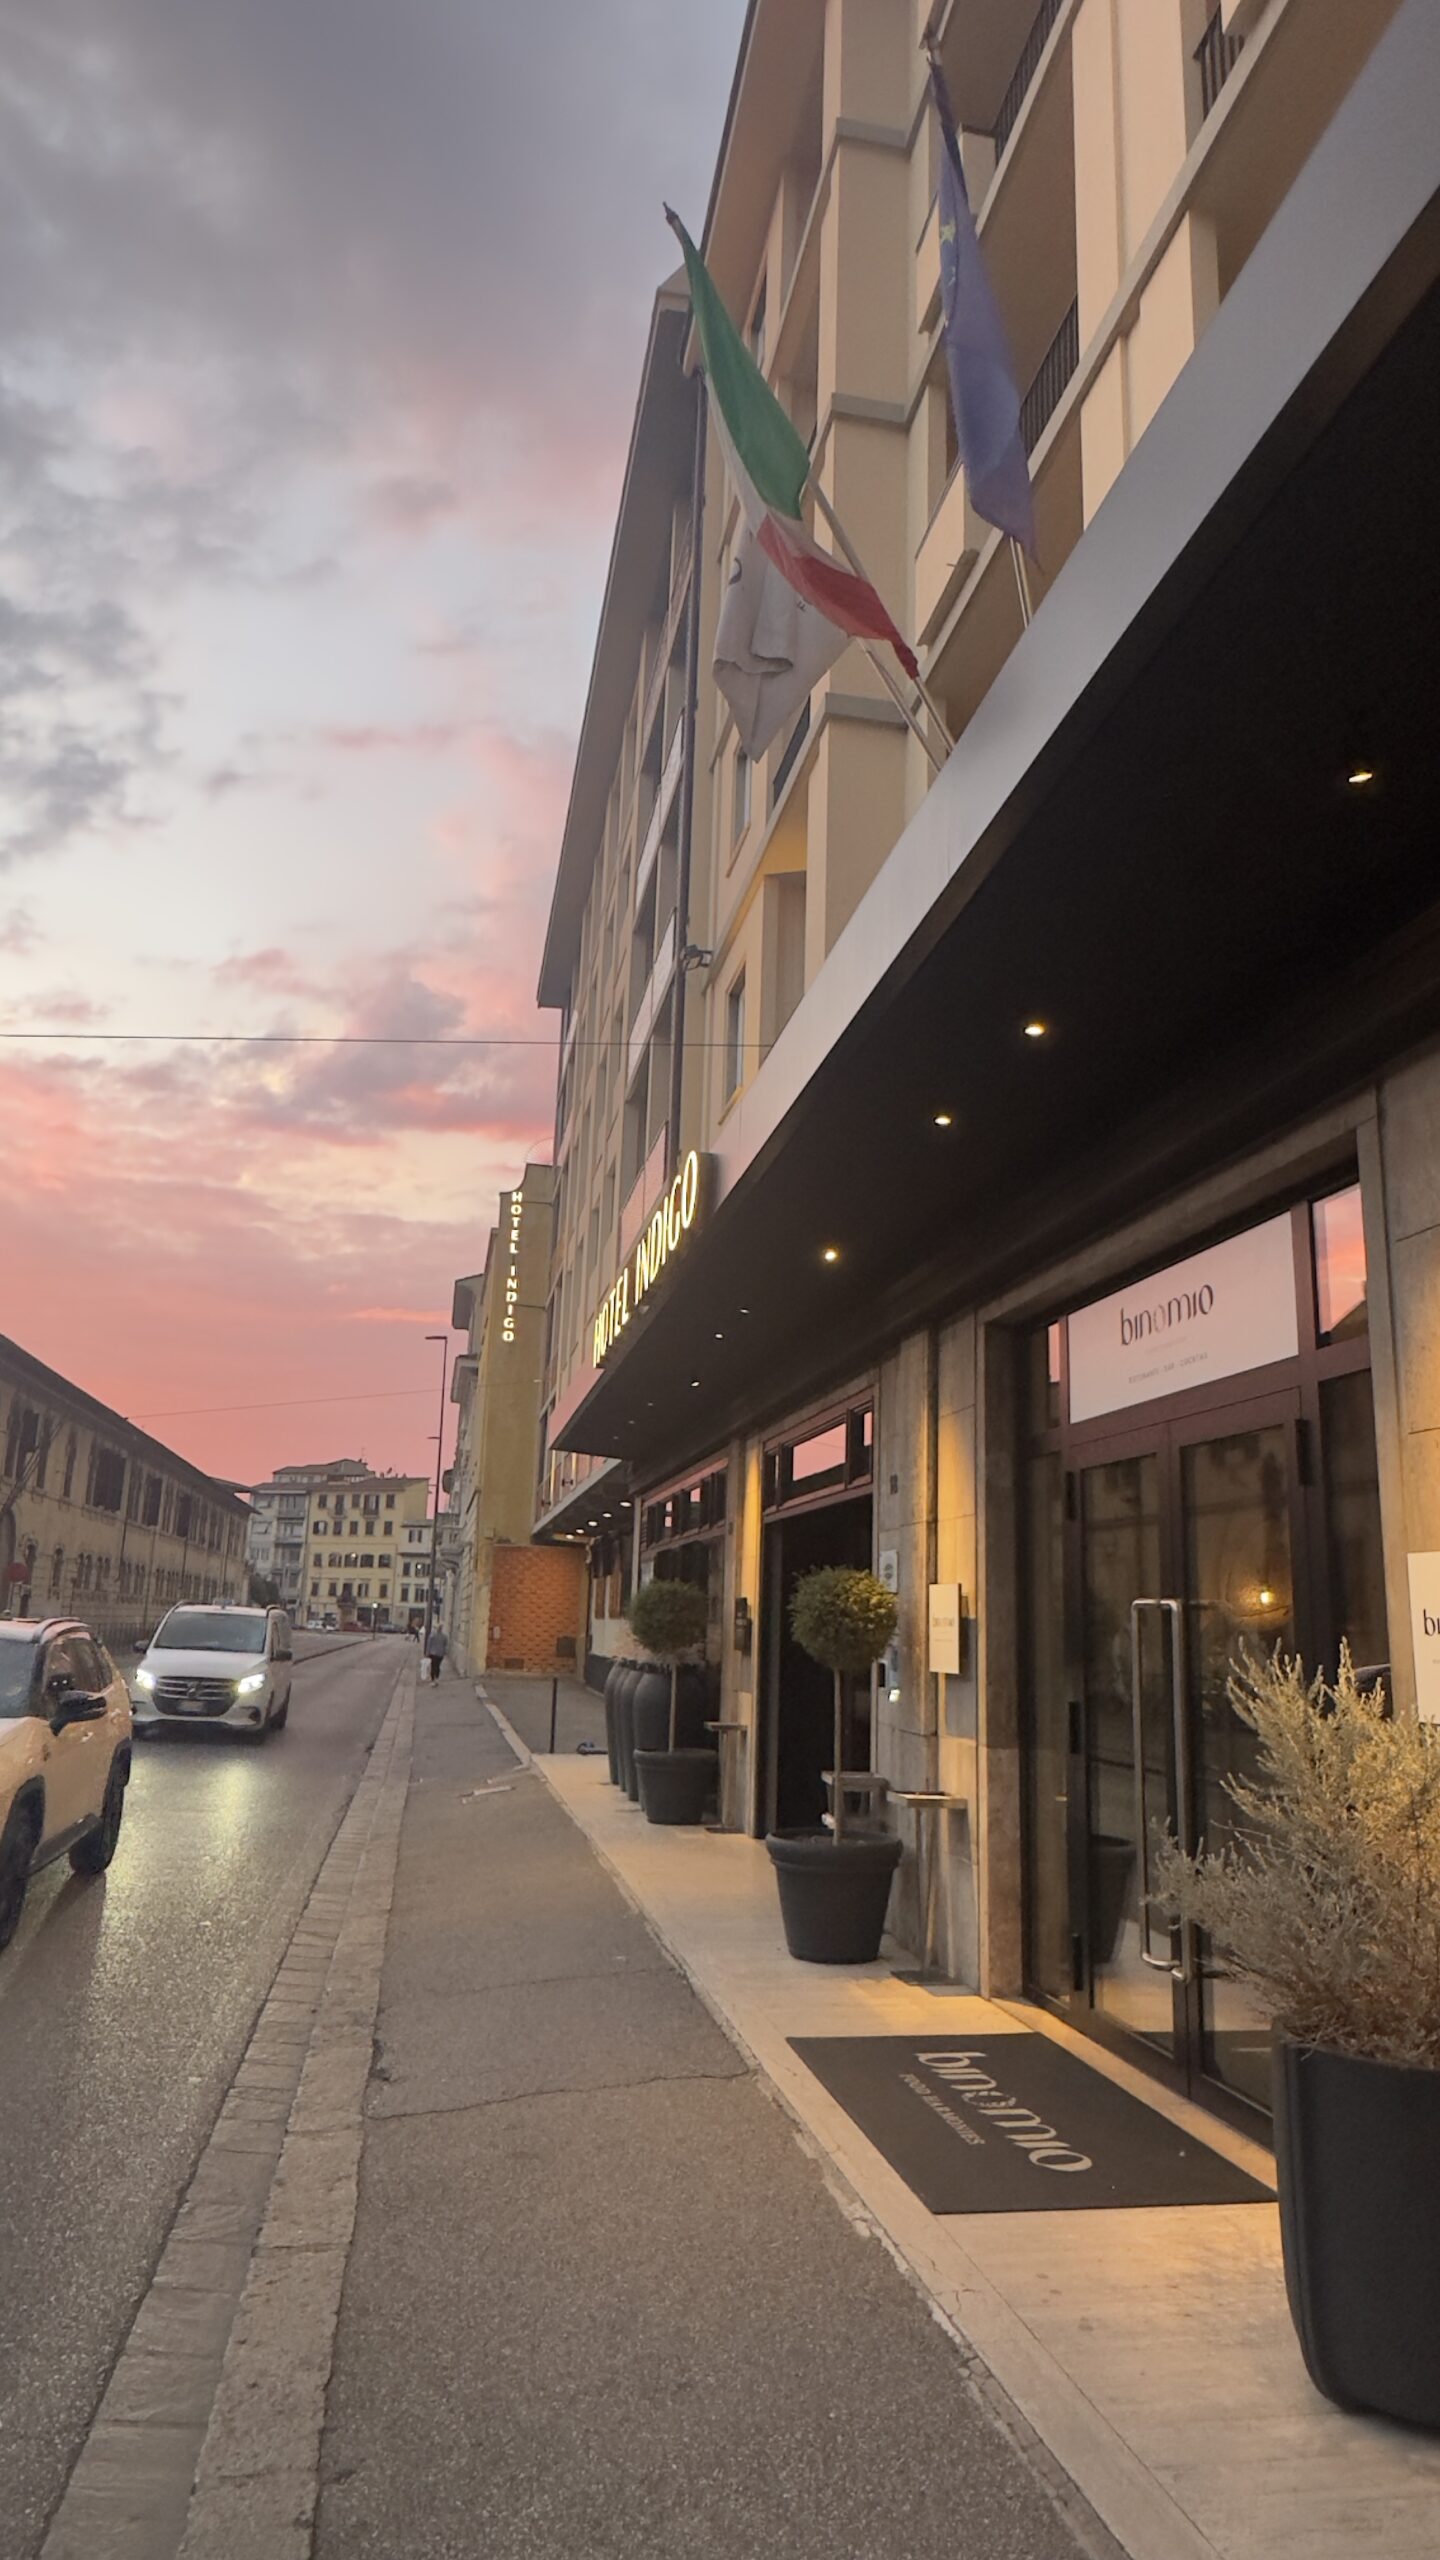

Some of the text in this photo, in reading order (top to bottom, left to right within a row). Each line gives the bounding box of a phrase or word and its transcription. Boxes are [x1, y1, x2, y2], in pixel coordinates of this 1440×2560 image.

[502, 1191, 523, 1342] HOTEL INDIGO
[593, 1150, 698, 1369] HOTEL INDIGO
[1120, 1283, 1215, 1346] binomio
[912, 2051, 1093, 2172] binomio
